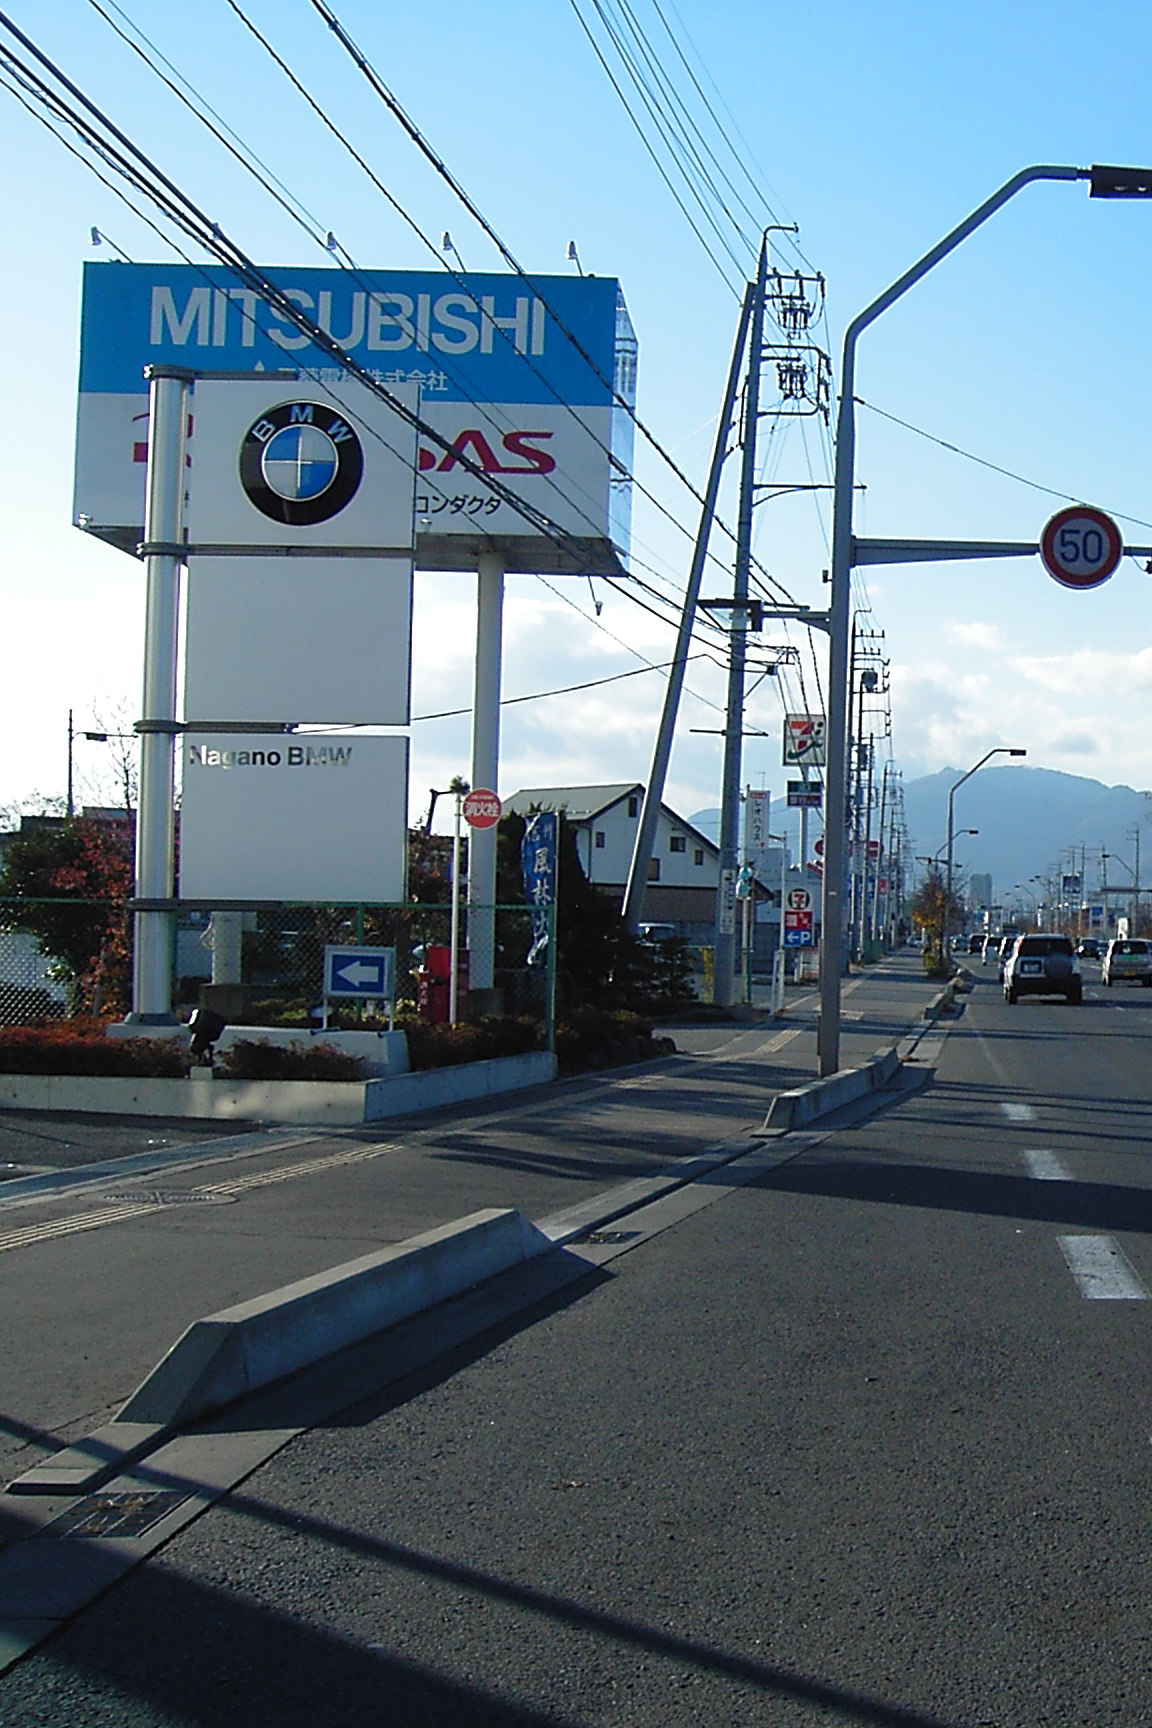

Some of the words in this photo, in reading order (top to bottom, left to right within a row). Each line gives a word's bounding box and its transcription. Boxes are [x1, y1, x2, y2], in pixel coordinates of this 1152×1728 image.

[150, 286, 545, 356] MITSUBISHI
[252, 405, 353, 443] BMW
[1061, 529, 1103, 564] 50
[190, 745, 281, 770] Nagano
[288, 746, 352, 767] BMW
[465, 801, 499, 818] 消火栓
[801, 930, 811, 944] P
